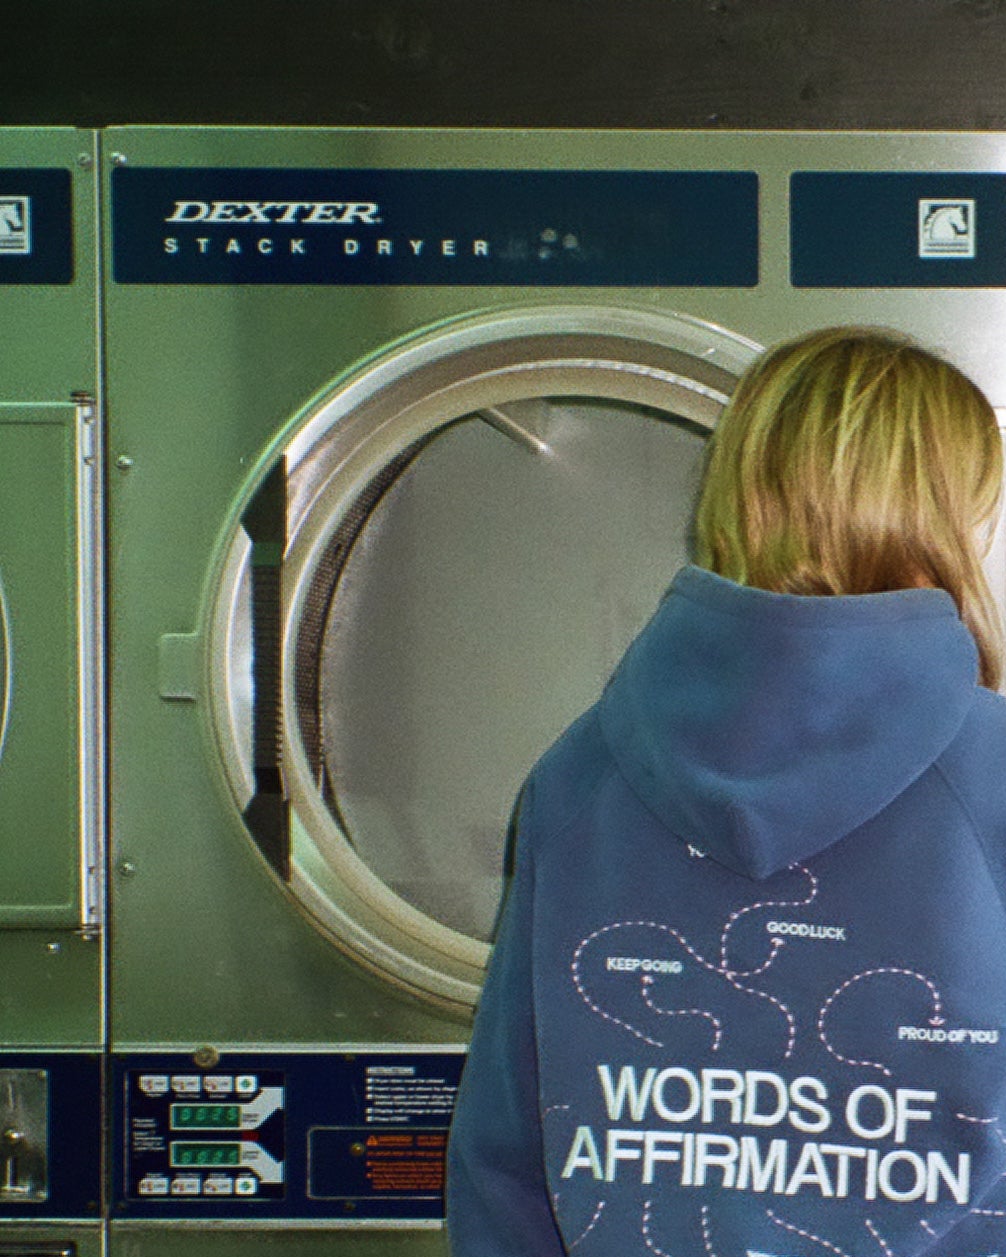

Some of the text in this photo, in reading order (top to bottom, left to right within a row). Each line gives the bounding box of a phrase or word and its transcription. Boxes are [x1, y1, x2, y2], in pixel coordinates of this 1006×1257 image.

[165, 201, 382, 223] DEXTER
[164, 238, 489, 256] STACK DRYER
[766, 921, 846, 941] GOOD LUCK
[606, 956, 683, 974] KEEP GOING
[898, 1026, 1000, 1044] PROUD OF YOU
[597, 1064, 937, 1143] WORDS OF
[561, 1125, 970, 1204] AFFIRMATION
